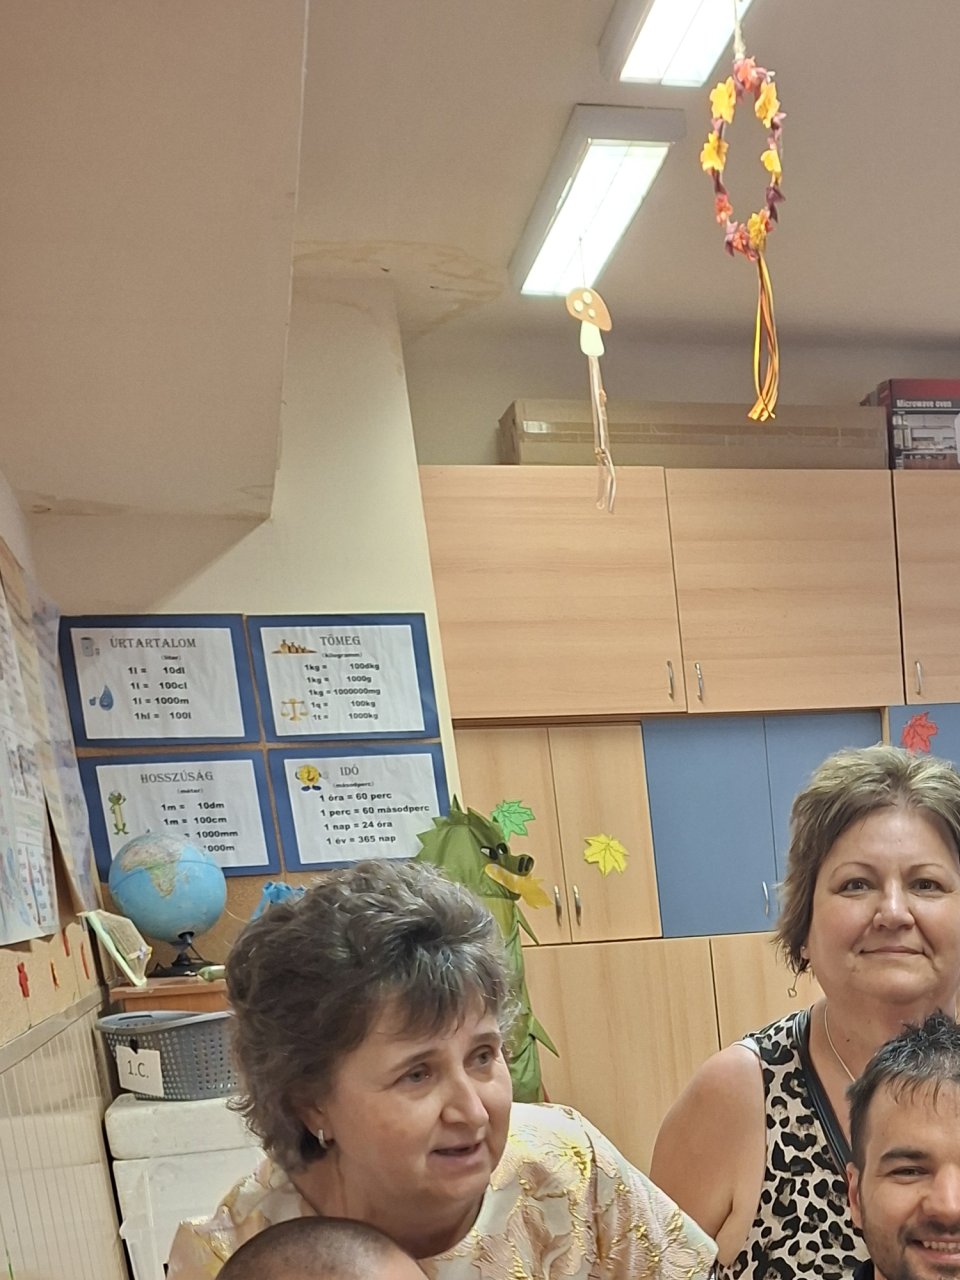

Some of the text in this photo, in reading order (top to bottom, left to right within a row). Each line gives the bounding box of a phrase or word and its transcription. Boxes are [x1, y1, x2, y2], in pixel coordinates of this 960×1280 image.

[896, 399, 952, 408] Microwave oven
[163, 666, 185, 674] 10dl
[304, 663, 320, 671] 1kg
[307, 676, 321, 684] 1kg
[346, 675, 372, 683] 1000g
[159, 681, 187, 689] 100cl
[350, 700, 376, 708] 100kg
[328, 793, 344, 801] óra
[355, 792, 368, 800] 60
[370, 793, 392, 801] perc
[197, 802, 224, 810] 10dm
[329, 809, 350, 817] perc
[377, 805, 430, 815] másodperc
[193, 816, 227, 824] 100cm
[333, 823, 350, 831] nap
[196, 830, 238, 838] 1000mm
[335, 836, 346, 844] év
[358, 835, 376, 843] 365
[378, 836, 396, 844] nap
[203, 844, 235, 852] 000m
[127, 1060, 149, 1078] 1.C.
